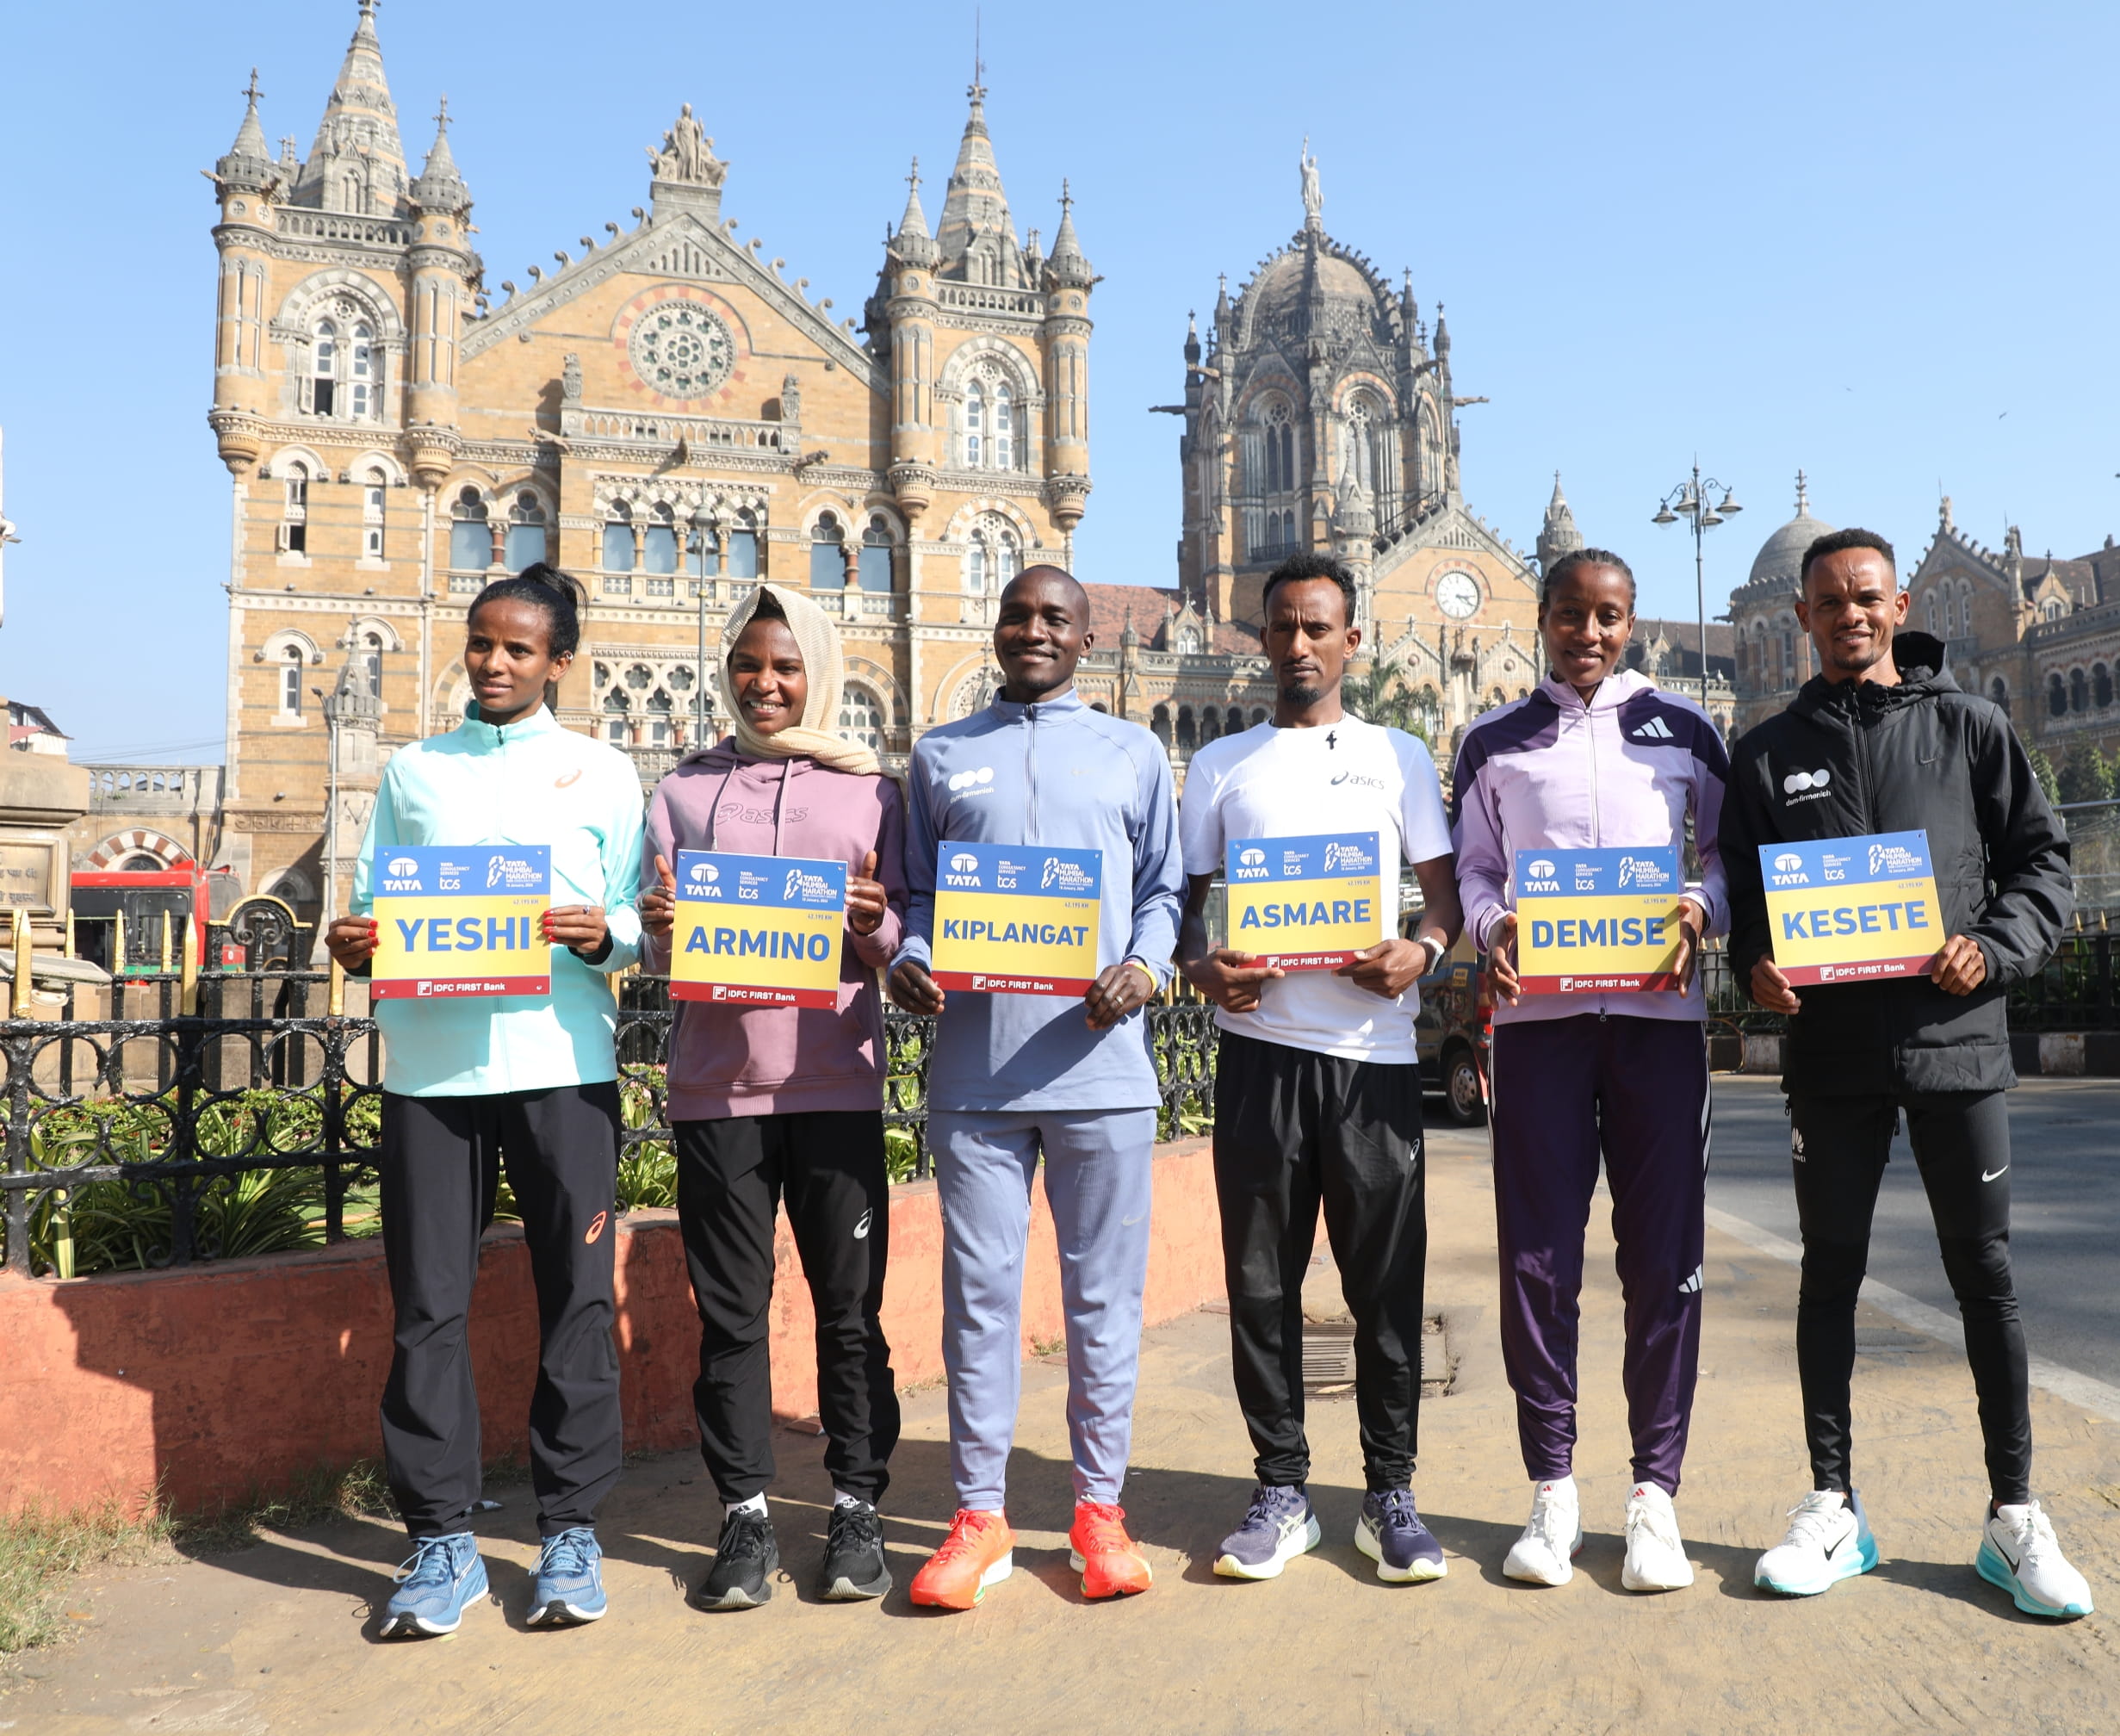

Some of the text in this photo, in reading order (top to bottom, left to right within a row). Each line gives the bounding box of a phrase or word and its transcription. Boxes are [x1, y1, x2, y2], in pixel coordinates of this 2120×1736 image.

[1340, 856, 1373, 865] MARATHON
[1887, 857, 1922, 866] MARATHON
[1237, 867, 1269, 878] TATA
[1283, 864, 1302, 876] tcs
[1825, 868, 1846, 881] tcs
[383, 880, 422, 890] TATA
[439, 877, 461, 890] tcs
[945, 874, 982, 887] TATA
[997, 875, 1017, 889] tcs
[1576, 877, 1595, 890] tcs
[1771, 873, 1810, 885] TATA
[685, 884, 722, 897] TATA
[738, 885, 759, 900] tcs
[802, 888, 837, 896] MARATHON
[1524, 881, 1560, 892] TATA
[1240, 899, 1371, 929] ASMARE
[1782, 900, 1929, 940] KESETE
[395, 916, 530, 952] YESHI
[943, 919, 1089, 946] KIPLANGAT
[1532, 917, 1665, 948] DEMISE
[685, 926, 830, 962] ARMINO
[1280, 955, 1343, 966] IDFC FIRST Bank
[1836, 964, 1906, 976] IDFC FIRST Bank
[434, 983, 505, 993] IDFC FIRST Bank
[988, 979, 1054, 991] IDFC FIRST Bank
[1575, 978, 1640, 989] IDFC FIRST Bank
[728, 989, 796, 1001] IDFC FIRST Bank
